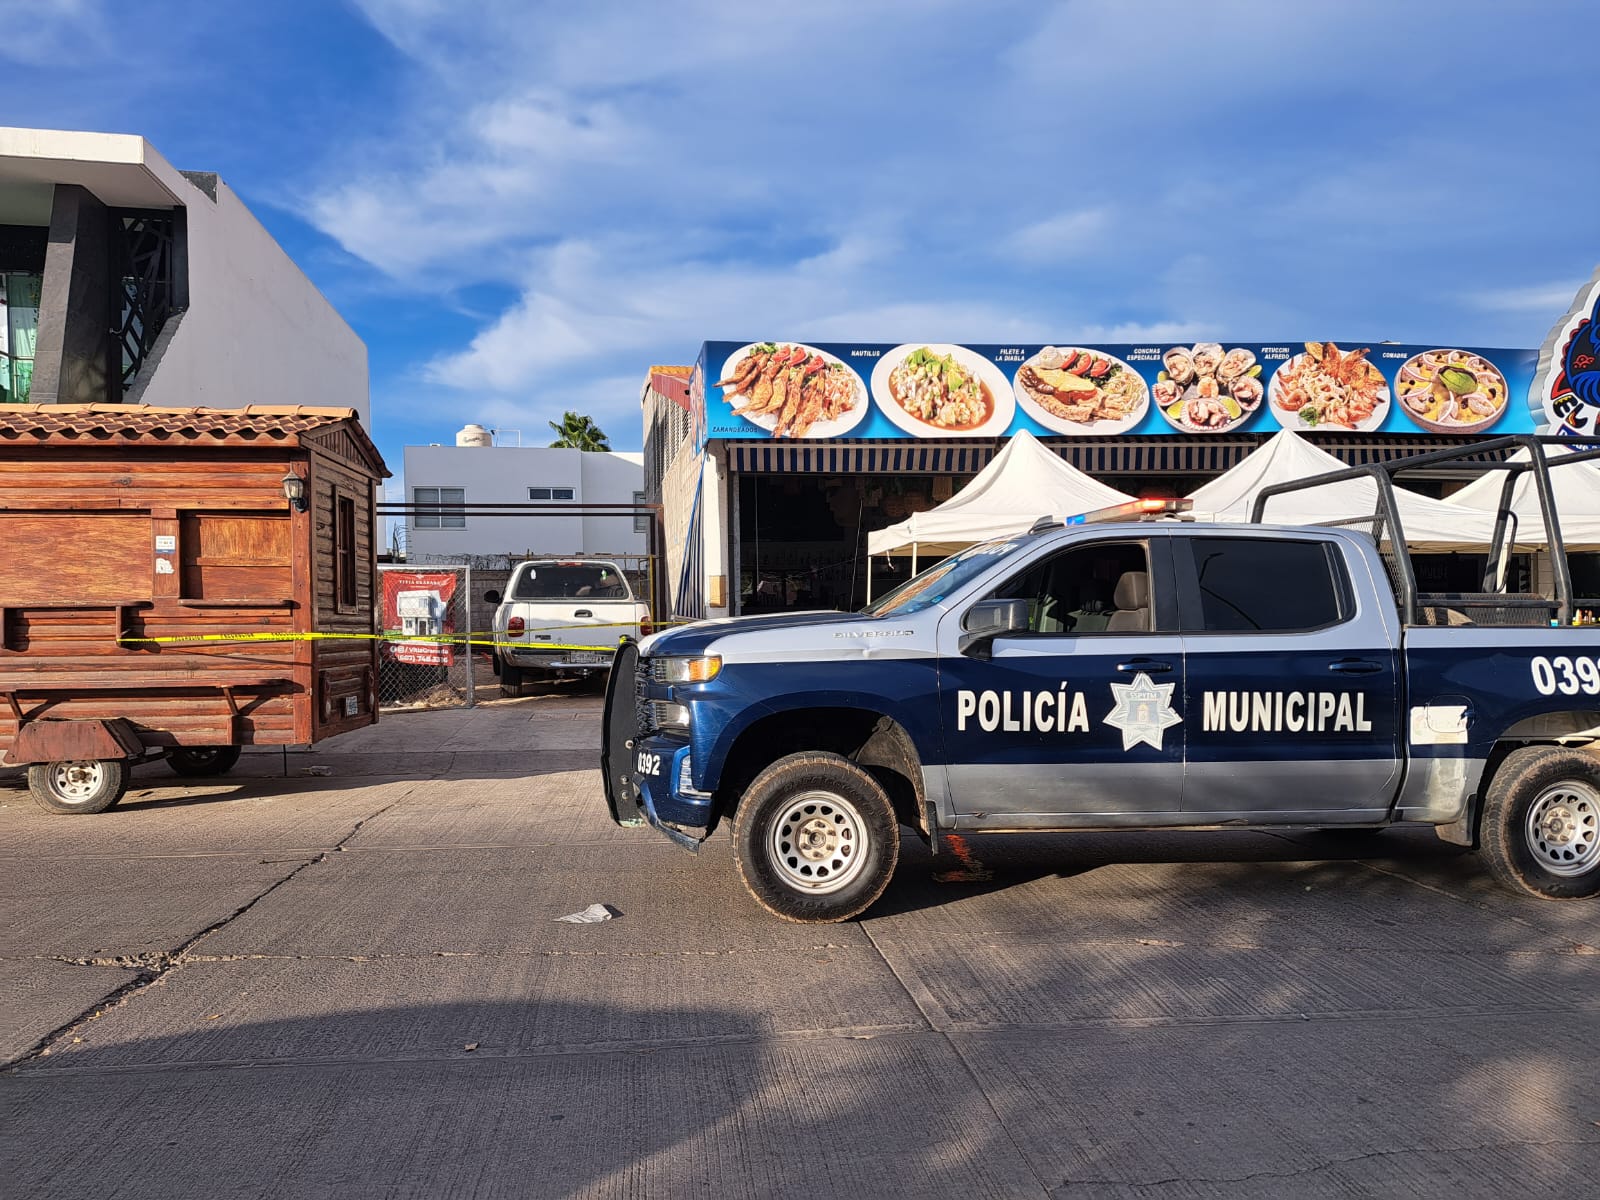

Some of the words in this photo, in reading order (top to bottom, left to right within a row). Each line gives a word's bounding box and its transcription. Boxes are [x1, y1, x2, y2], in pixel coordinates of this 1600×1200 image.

[832, 630, 914, 639] SILVERADO
[1531, 656, 1600, 695] 039
[957, 681, 1090, 732] POLICÍA
[1203, 691, 1372, 732] MUNICIPAL
[637, 751, 661, 776] 0392
